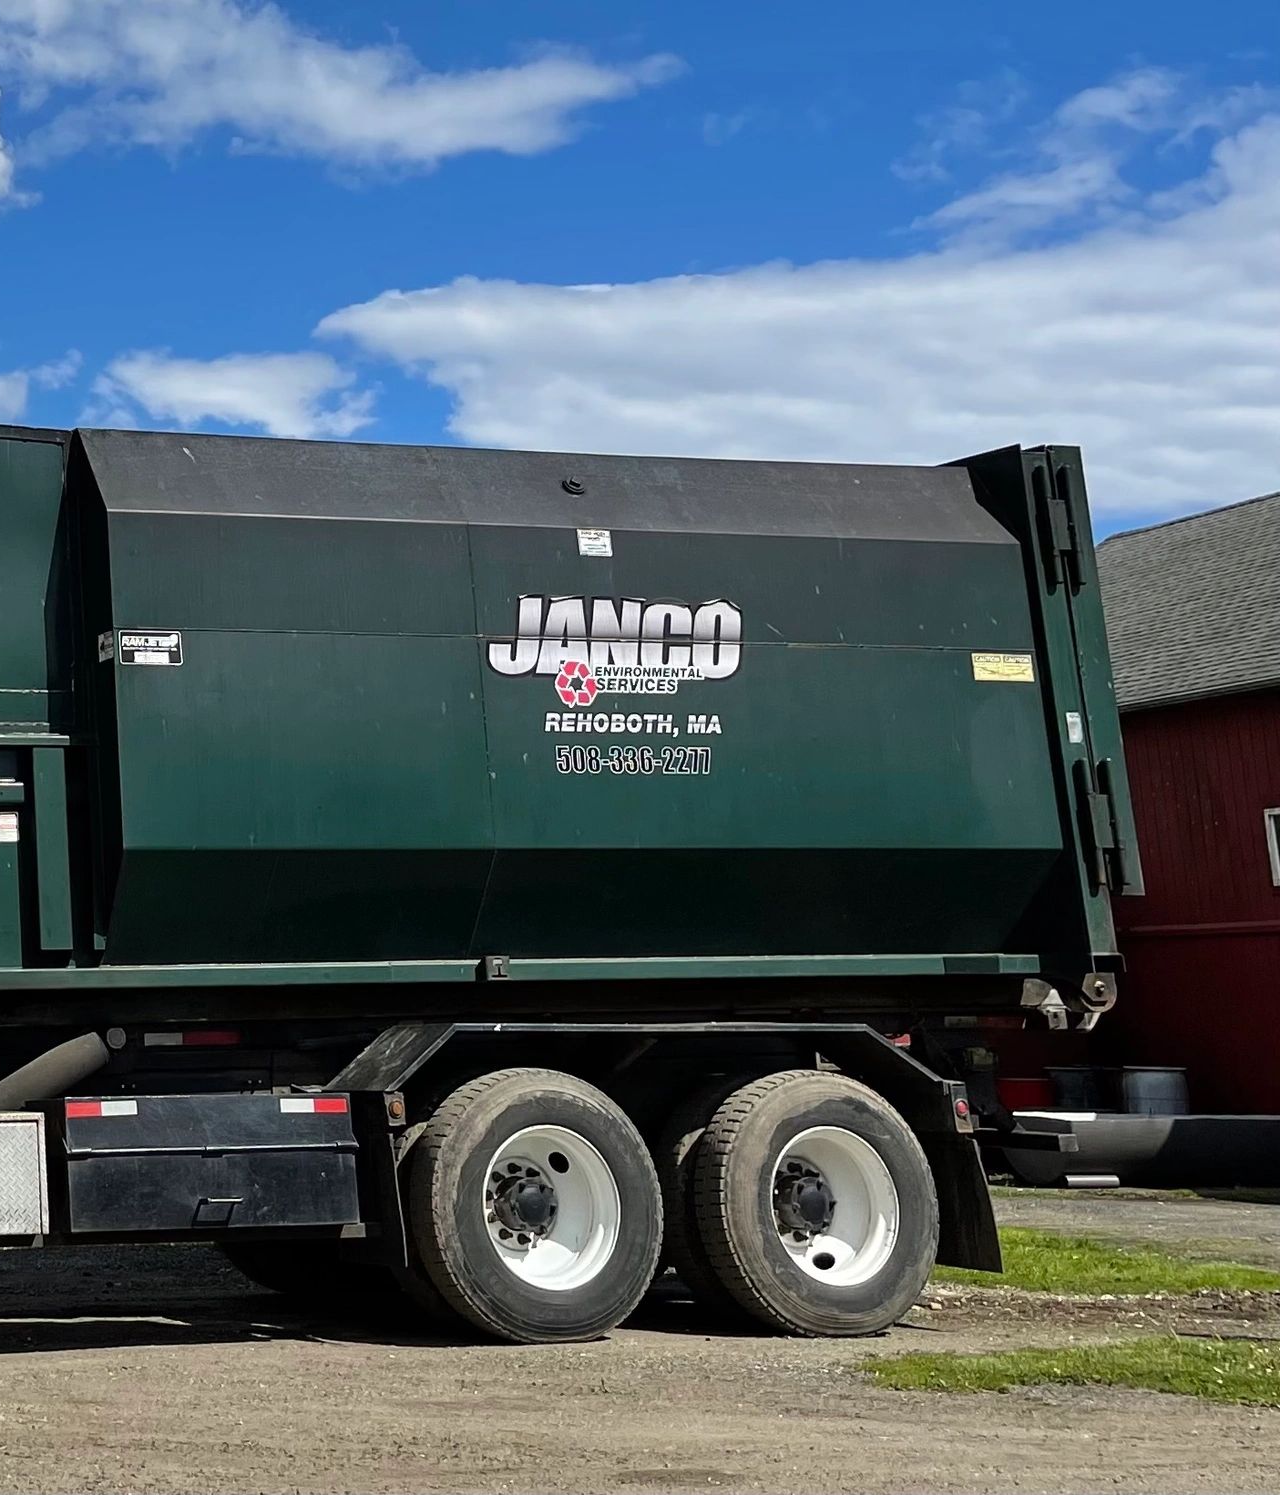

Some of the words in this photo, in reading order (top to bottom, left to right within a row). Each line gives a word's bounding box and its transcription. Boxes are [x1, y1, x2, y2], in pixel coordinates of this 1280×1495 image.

[488, 594, 742, 680] JANCO
[595, 666, 703, 679] ENVIRONMENTAL
[596, 678, 676, 692] SERVICES
[544, 712, 679, 737] REHOBOTH,
[687, 714, 722, 734] MA
[555, 745, 711, 774] 508-336-2277
